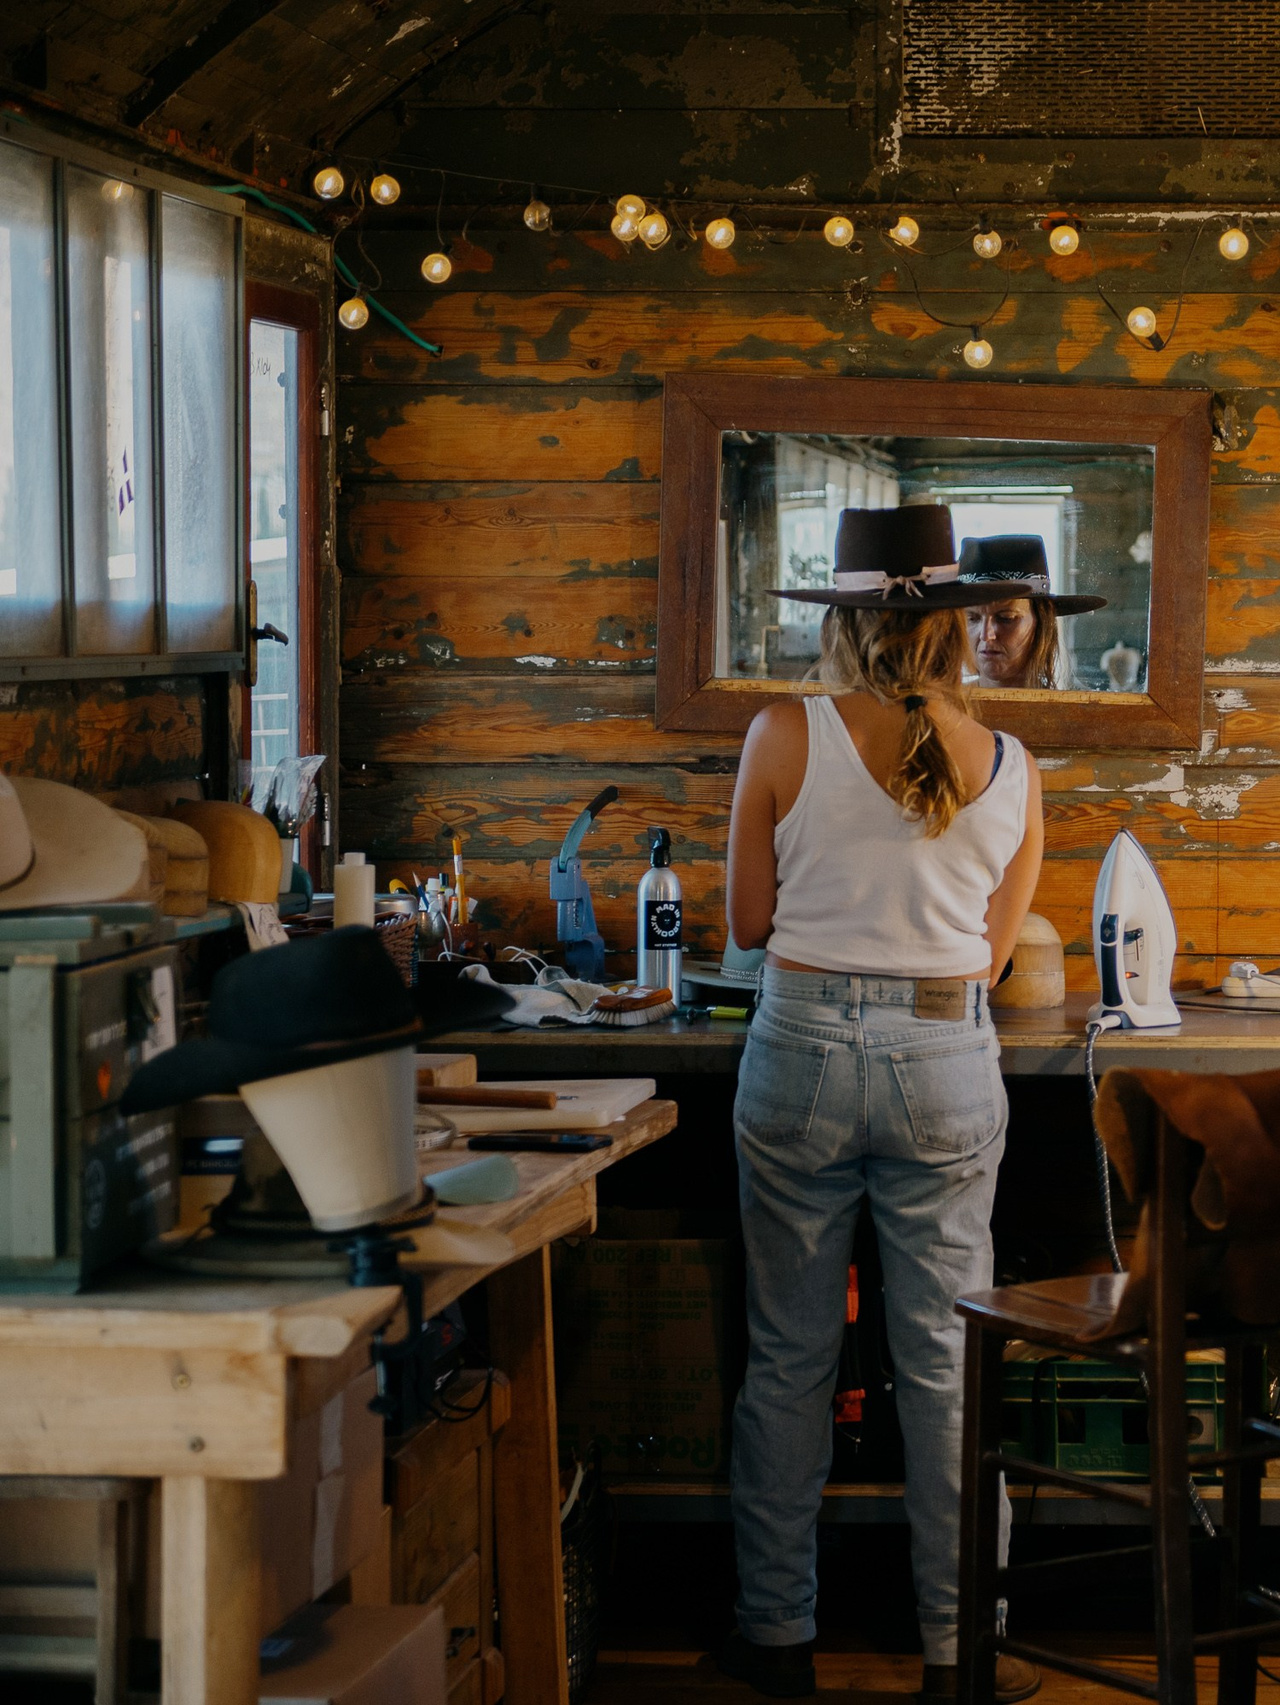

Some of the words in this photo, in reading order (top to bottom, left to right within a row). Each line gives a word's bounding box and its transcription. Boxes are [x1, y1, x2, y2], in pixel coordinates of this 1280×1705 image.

[655, 903, 676, 914] MAD
[650, 915, 681, 938] BROOKLYN
[923, 989, 959, 1001] Wrangler
